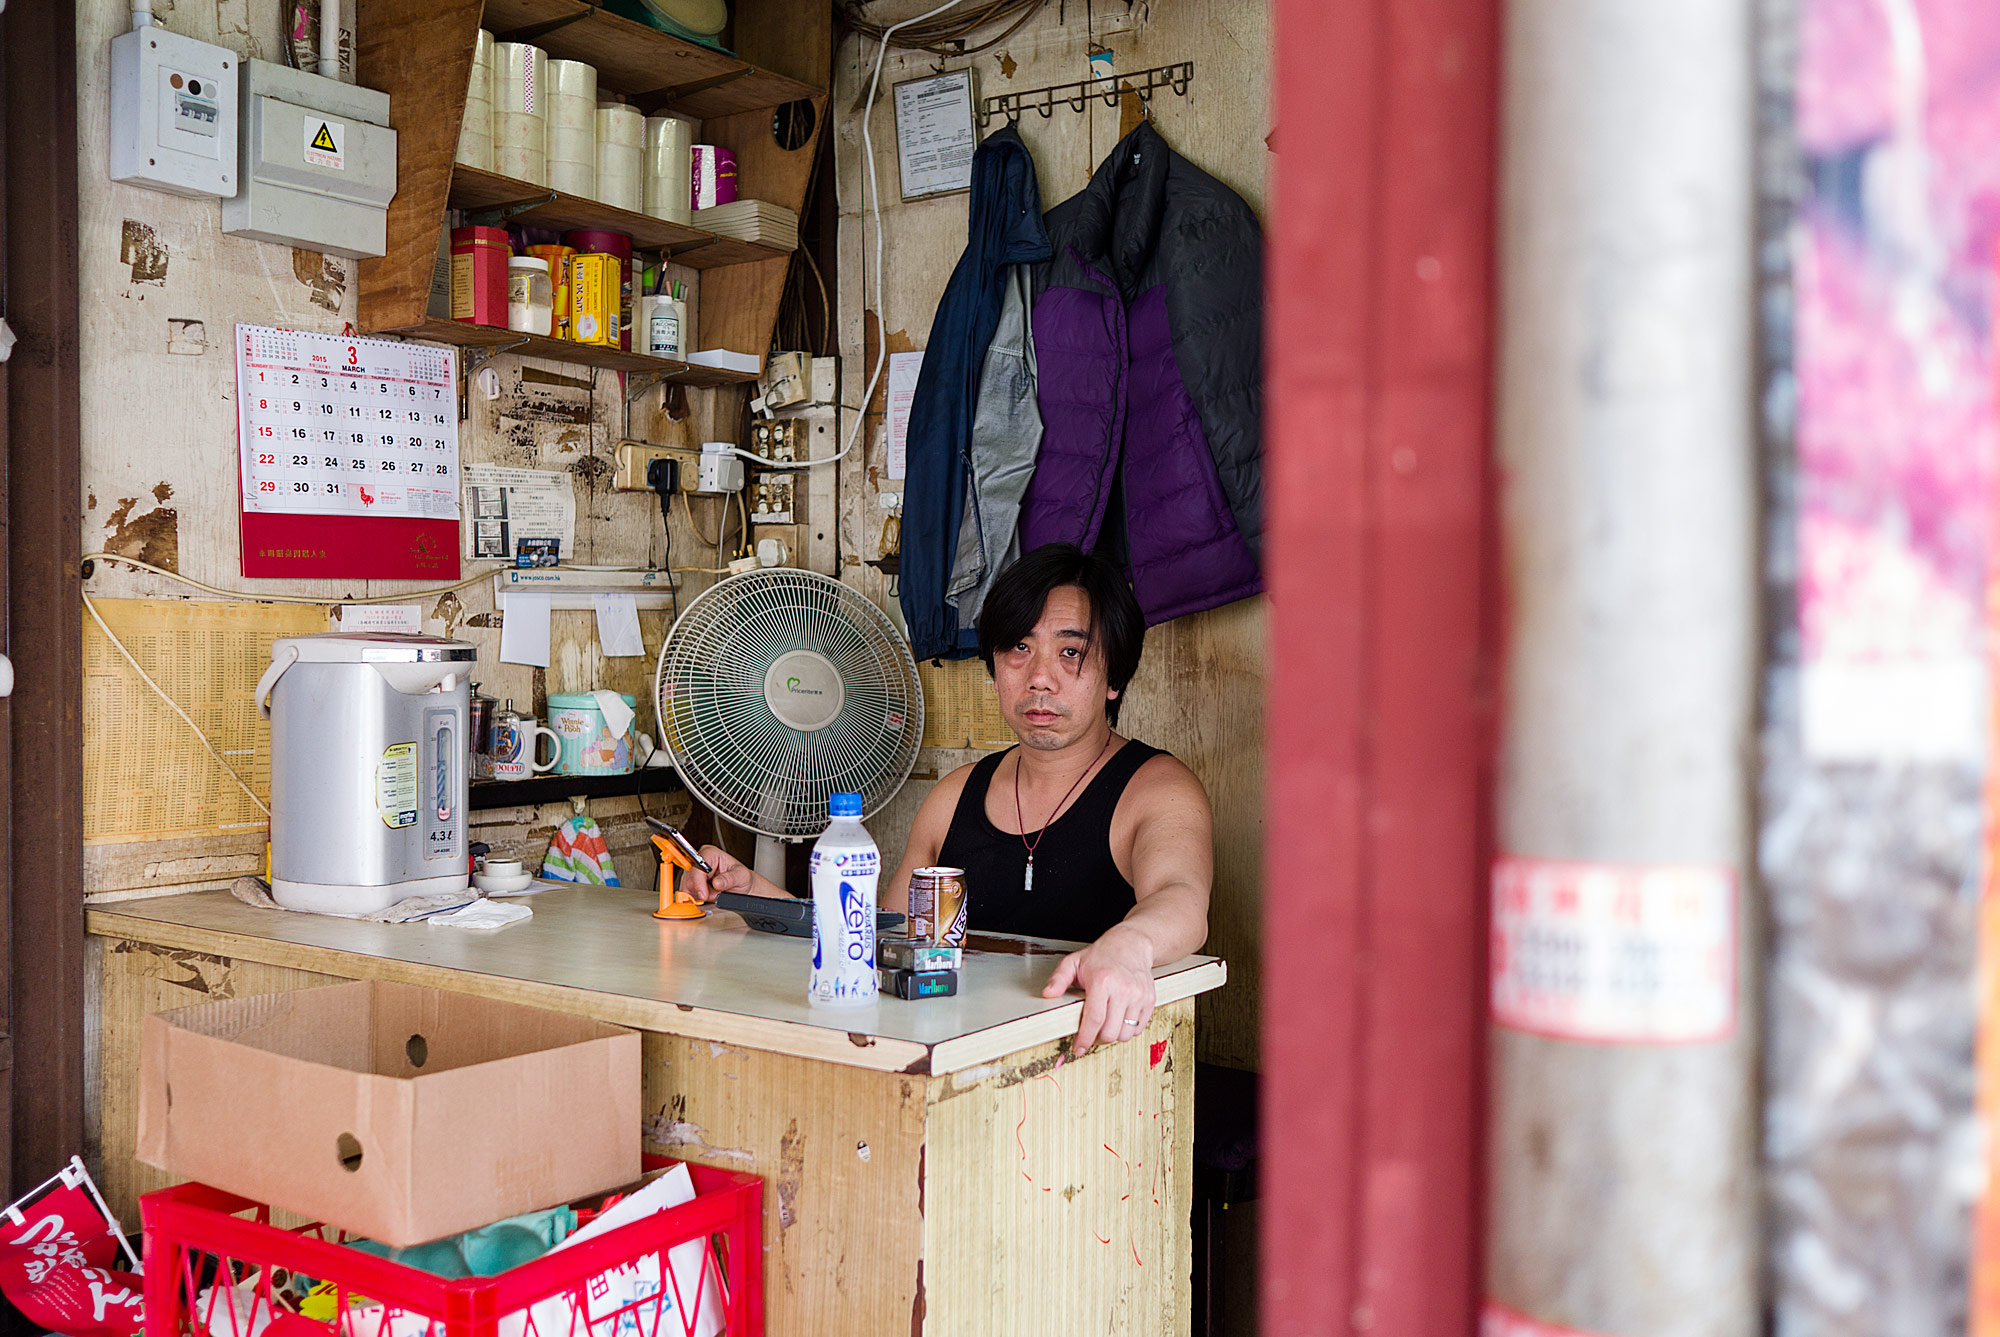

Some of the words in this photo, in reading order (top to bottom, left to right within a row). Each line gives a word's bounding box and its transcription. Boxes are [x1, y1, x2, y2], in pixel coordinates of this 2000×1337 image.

[312, 354, 327, 363] 2015
[347, 346, 358, 365] 3
[341, 364, 366, 374] MARCH
[258, 372, 263, 381] 1
[291, 375, 298, 384] 2
[321, 378, 327, 387] 3
[350, 381, 356, 390] 4
[380, 384, 387, 392] 5
[408, 387, 415, 395] 6
[434, 390, 440, 398] 7
[259, 400, 267, 409] 8
[293, 402, 300, 411] 9
[320, 405, 332, 414] 10
[349, 408, 359, 416] 11
[379, 410, 391, 419] 12
[408, 412, 419, 421] 13
[433, 415, 444, 424] 14
[258, 427, 272, 436] 15
[292, 429, 305, 438] 16
[323, 431, 334, 440] 17
[350, 434, 363, 443] 18
[380, 436, 393, 444] 19
[409, 438, 421, 446] 20
[435, 440, 444, 449] 21
[259, 454, 274, 463] 22
[292, 456, 307, 465] 23
[324, 457, 337, 467] 24
[352, 460, 365, 469] 25
[381, 461, 395, 470] 26
[411, 463, 423, 472] 27
[436, 465, 447, 474] 28
[260, 482, 275, 491] 29
[293, 483, 309, 492] 30
[326, 484, 338, 493] 31
[561, 717, 584, 727] Winnie
[564, 724, 581, 734] Pooh
[864, 901, 873, 949] AQUARIUS
[924, 955, 953, 970] Marlboro
[918, 979, 949, 995] Marlboro
